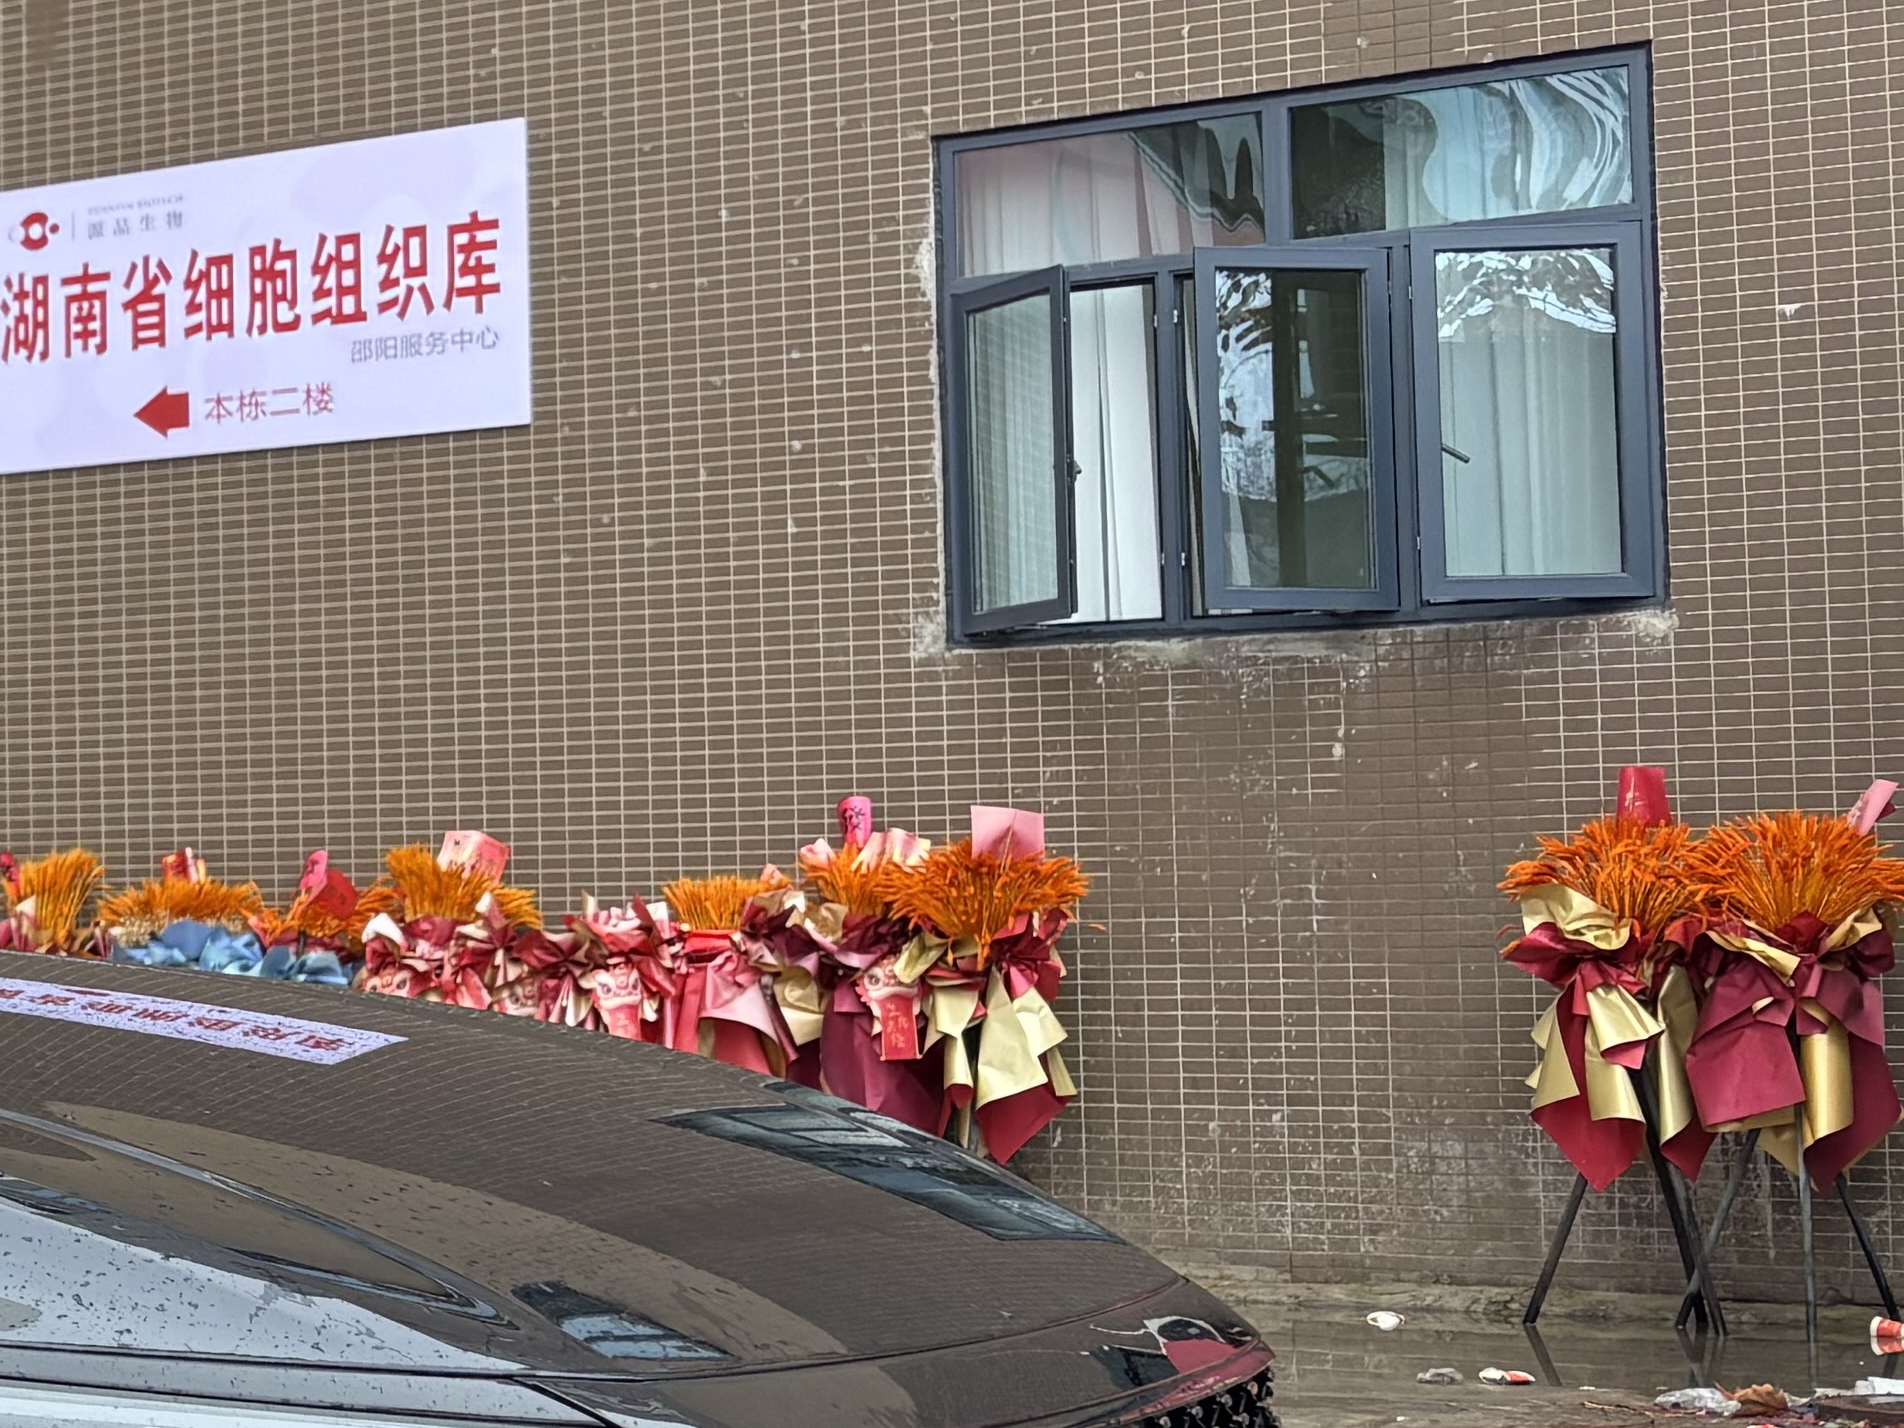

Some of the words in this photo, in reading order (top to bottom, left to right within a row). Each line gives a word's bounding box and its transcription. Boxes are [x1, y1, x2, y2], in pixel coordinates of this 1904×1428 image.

[0, 210, 501, 365] 湖南省细胞组织库
[350, 325, 500, 363] 邵阳服务中心
[203, 381, 335, 423] 本栋二楼
